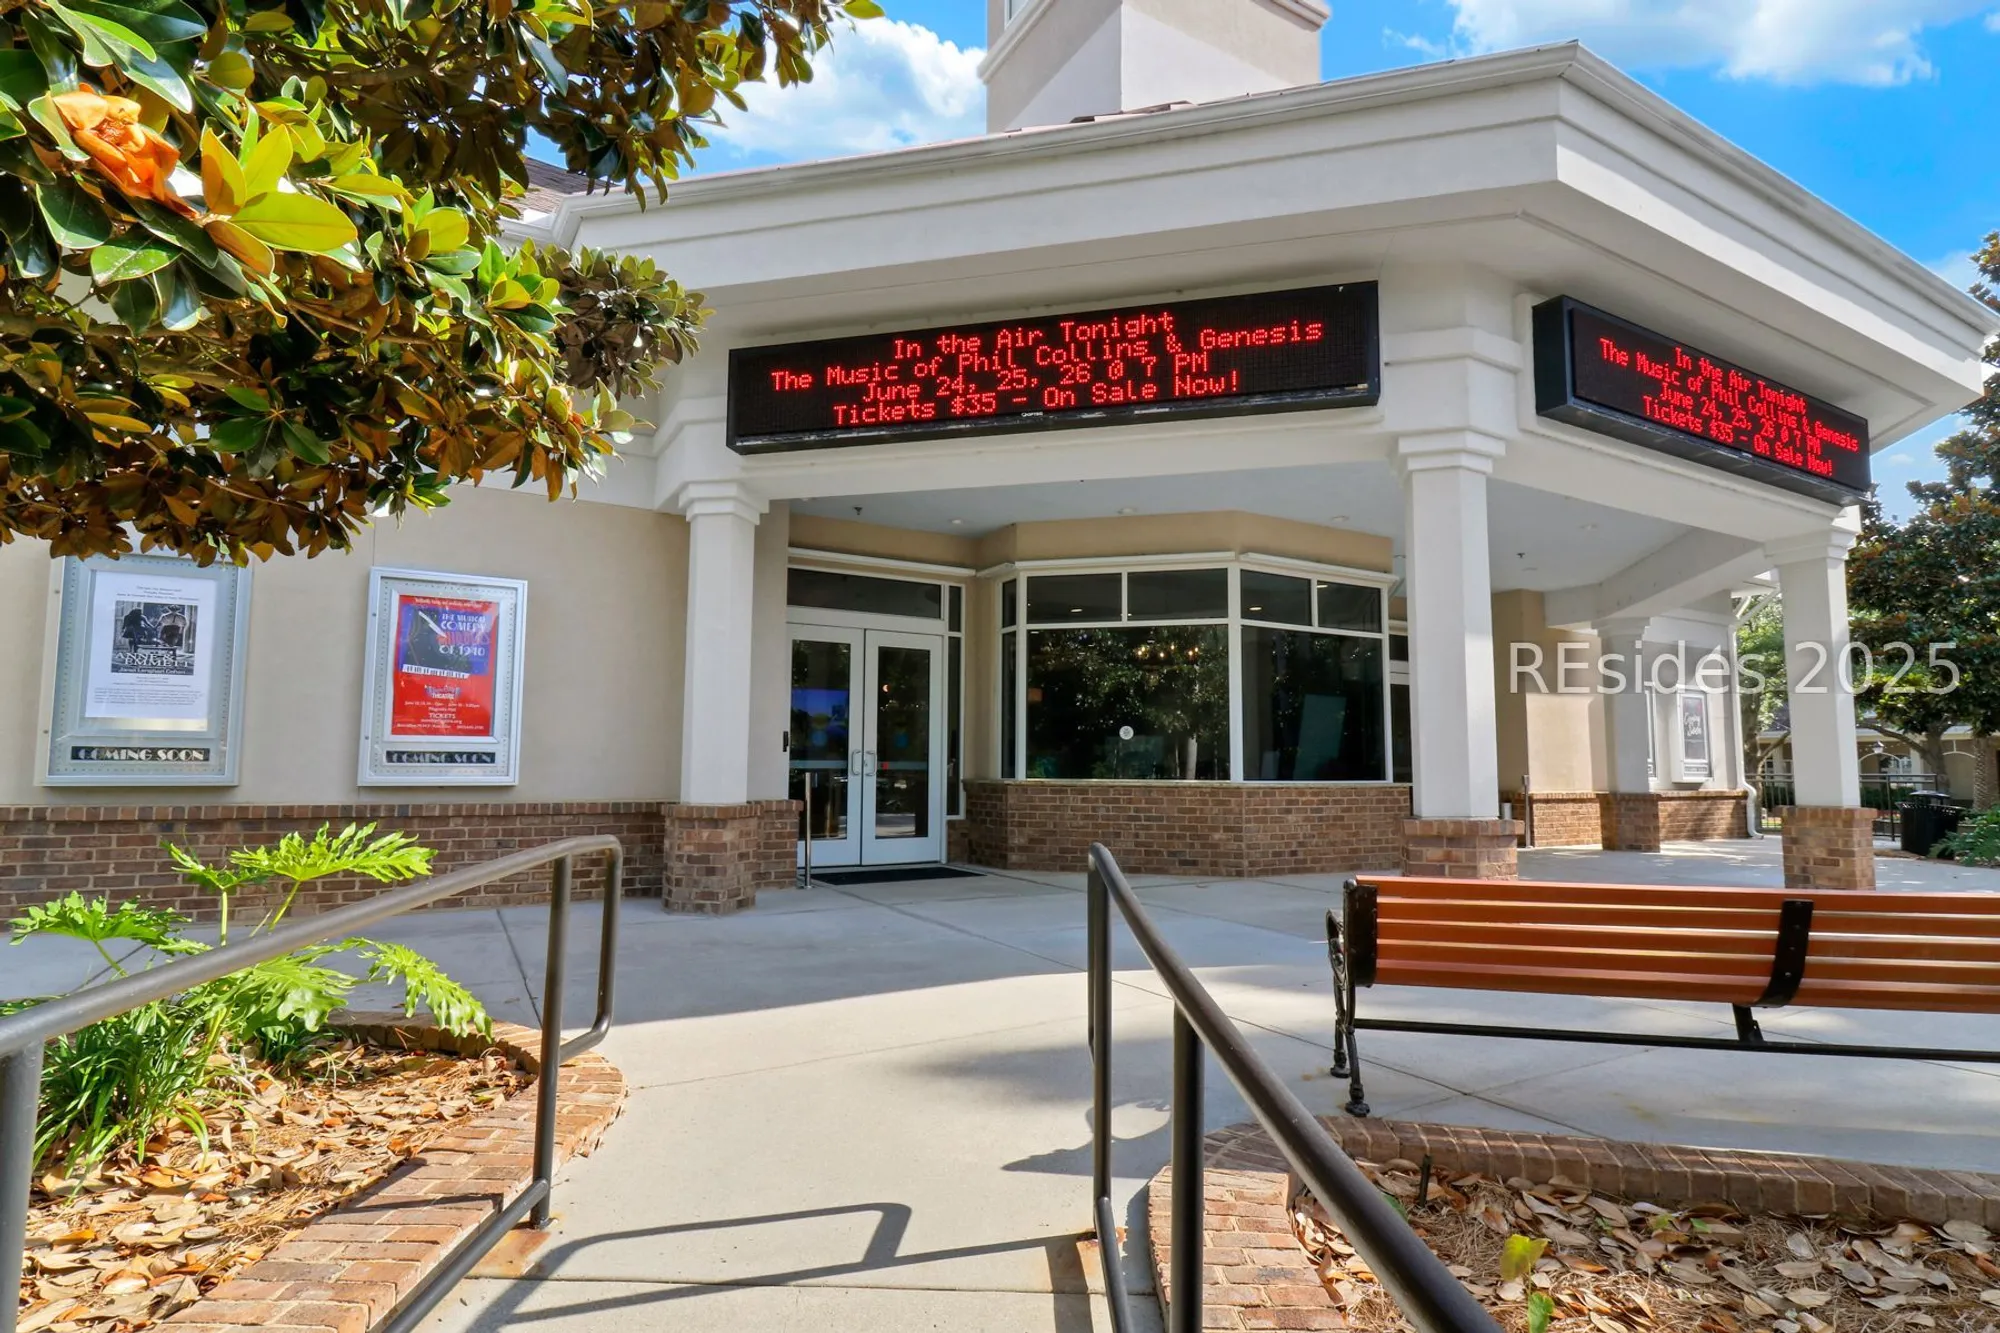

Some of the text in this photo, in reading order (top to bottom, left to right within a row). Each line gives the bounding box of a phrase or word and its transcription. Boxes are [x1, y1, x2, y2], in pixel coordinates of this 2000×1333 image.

[772, 320, 1322, 391] The Music of Phil Collins & Genesis
[894, 311, 1174, 360] In the Air Tonight
[834, 400, 935, 426] Tickets
[951, 392, 997, 416] $35
[1044, 386, 1076, 408] On
[1092, 380, 1157, 403] Sale
[1175, 370, 1238, 398] Now!
[863, 382, 920, 403] June
[936, 374, 977, 394] 24,
[997, 369, 1039, 391] 25,
[1060, 363, 1091, 386] 26
[1142, 356, 1157, 377] 7
[1175, 350, 1208, 374] PM
[1599, 337, 1629, 368] The
[1636, 352, 1681, 386] Music
[1687, 375, 1704, 394] of
[1711, 381, 1740, 408] Phil
[1747, 395, 1798, 430] Collins
[1815, 420, 1860, 453] Genesis
[1674, 346, 1806, 414] In the Air Tonight
[1642, 395, 1703, 434] Tickets
[1710, 420, 1734, 444] $35
[1754, 434, 1770, 456] On
[1774, 442, 1803, 467] Sale
[1807, 453, 1833, 476] Now!
[1660, 382, 1694, 410] June
[1700, 396, 1722, 420] 24,
[1731, 408, 1752, 431] 25,
[1760, 418, 1776, 438] 26
[1793, 430, 1802, 448] 7
[1806, 434, 1822, 456] PM
[459, 645, 486, 656] 1940
[77, 748, 205, 762] COMING SOON
